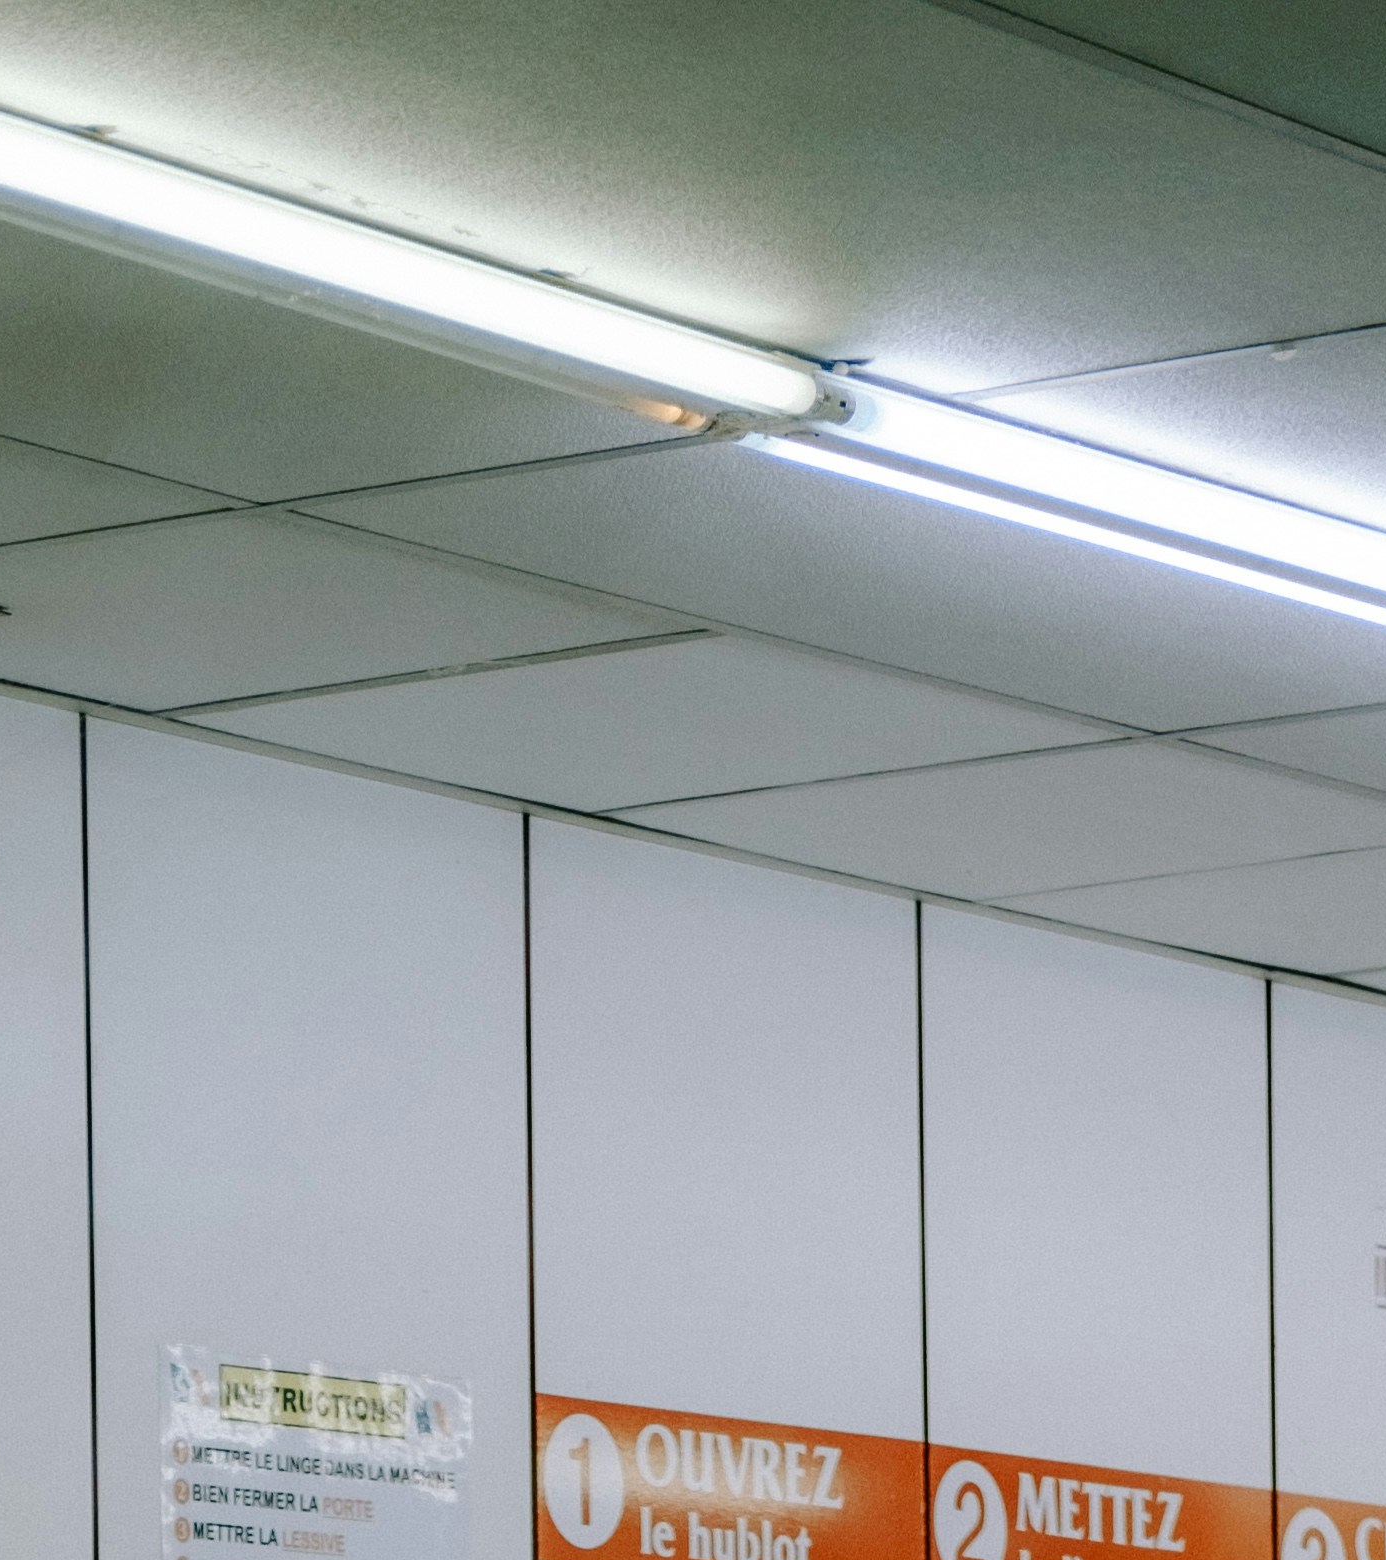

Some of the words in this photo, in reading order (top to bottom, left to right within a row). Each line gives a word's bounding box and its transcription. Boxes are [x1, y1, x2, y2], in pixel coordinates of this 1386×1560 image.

[635, 1422, 845, 1510] OUVREZ
[639, 1506, 676, 1558] le
[1015, 1472, 1186, 1553] METTEZ
